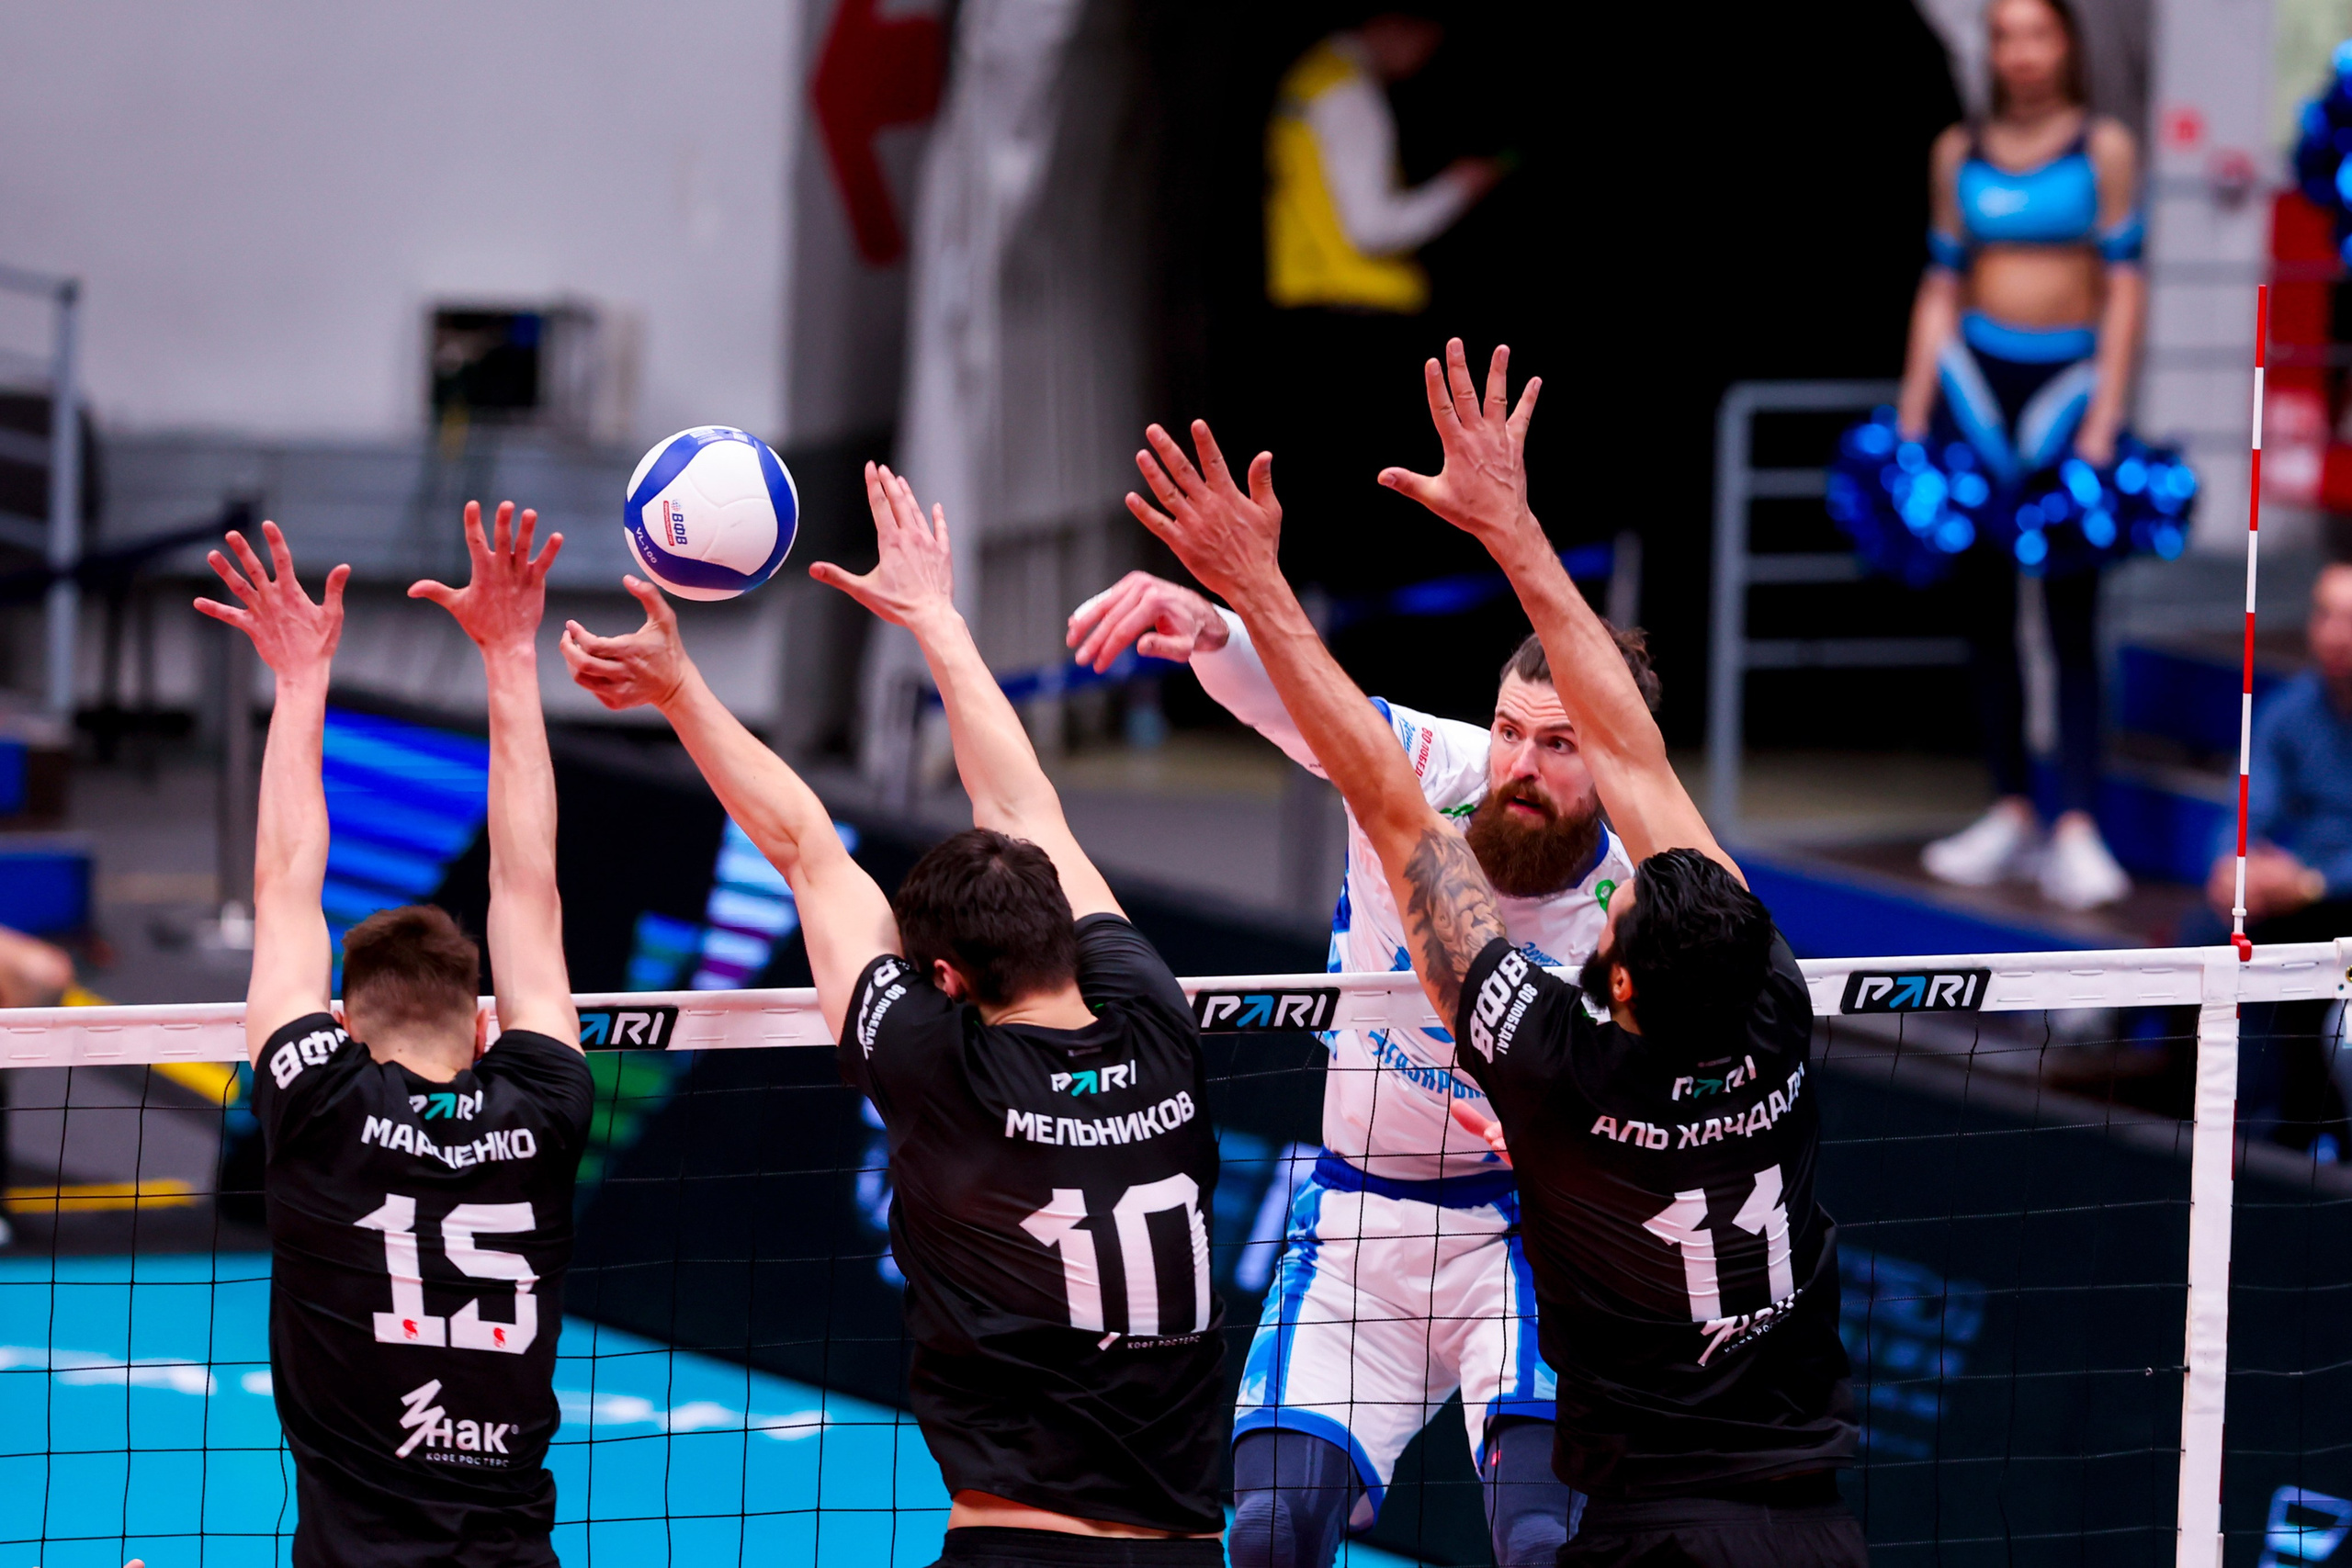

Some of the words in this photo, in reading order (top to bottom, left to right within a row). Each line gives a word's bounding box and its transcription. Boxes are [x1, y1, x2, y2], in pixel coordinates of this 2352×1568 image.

[636, 526, 658, 563] VL-100
[672, 513, 688, 545] ВФВ
[1421, 727, 1433, 744] 80
[1415, 743, 1430, 778] ПОБЕД
[885, 983, 907, 1001] 80
[1518, 983, 1539, 1004] 80
[1854, 974, 1977, 1009] PARI
[580, 1011, 664, 1044] ARI
[1201, 994, 1327, 1028] PARI
[1496, 999, 1528, 1055] ПОБЕДА!
[1050, 1059, 1136, 1097] PARI
[409, 1089, 483, 1121] PARI
[1005, 1090, 1194, 1146] МЕЛЬНИКОВ
[1590, 1115, 1668, 1150] АЛЬ
[1019, 1173, 1211, 1336] 10
[1642, 1164, 1793, 1322] 11
[353, 1193, 540, 1355] 15
[395, 1378, 510, 1459] Знак
